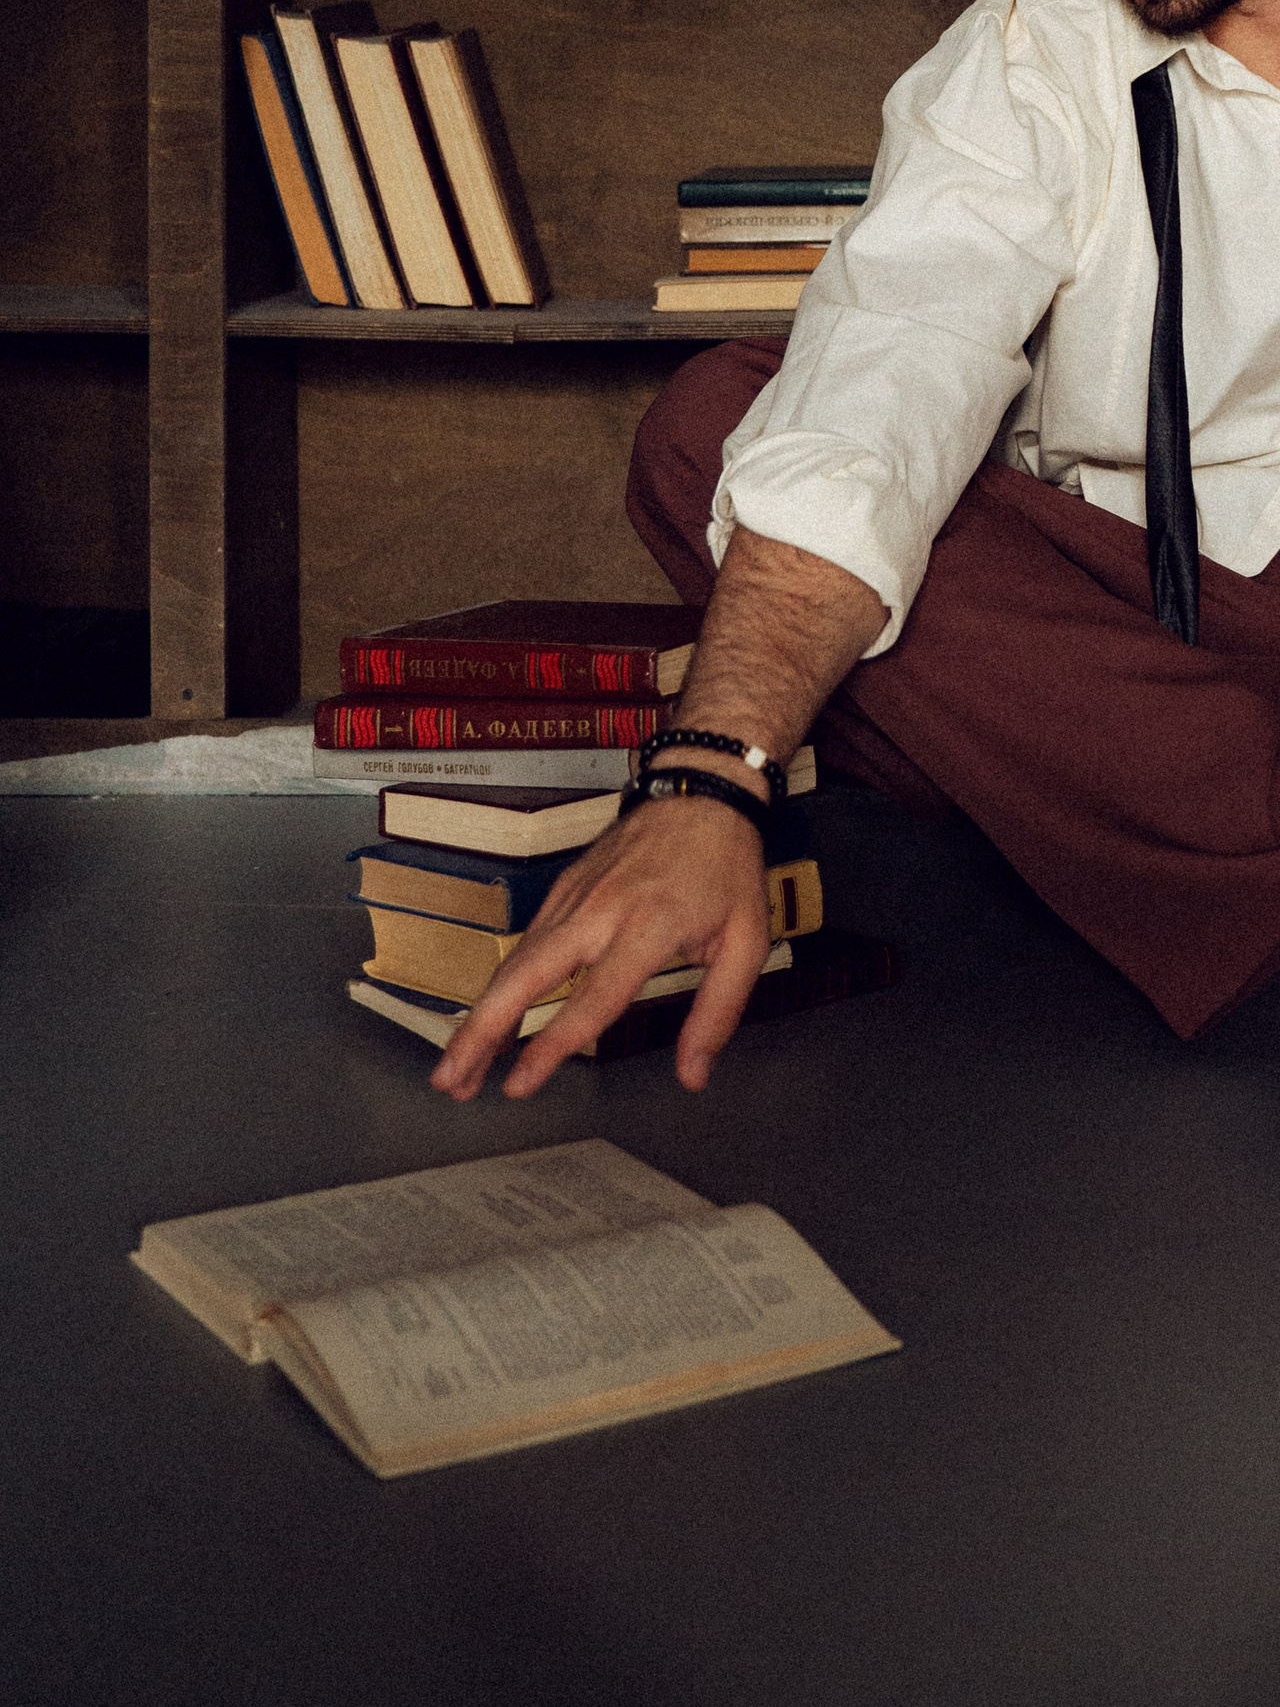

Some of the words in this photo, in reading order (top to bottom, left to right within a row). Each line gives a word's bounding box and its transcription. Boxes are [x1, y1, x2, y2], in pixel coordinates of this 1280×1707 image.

[409, 658, 498, 680] ФАДЕЕВ
[461, 723, 483, 739] А.
[488, 718, 592, 744] ФАДЕЕВ
[363, 760, 394, 773] СЕРГЕЙ
[398, 761, 434, 775] ГОЛУБОВ
[444, 763, 492, 777] БАГРАТИОН
